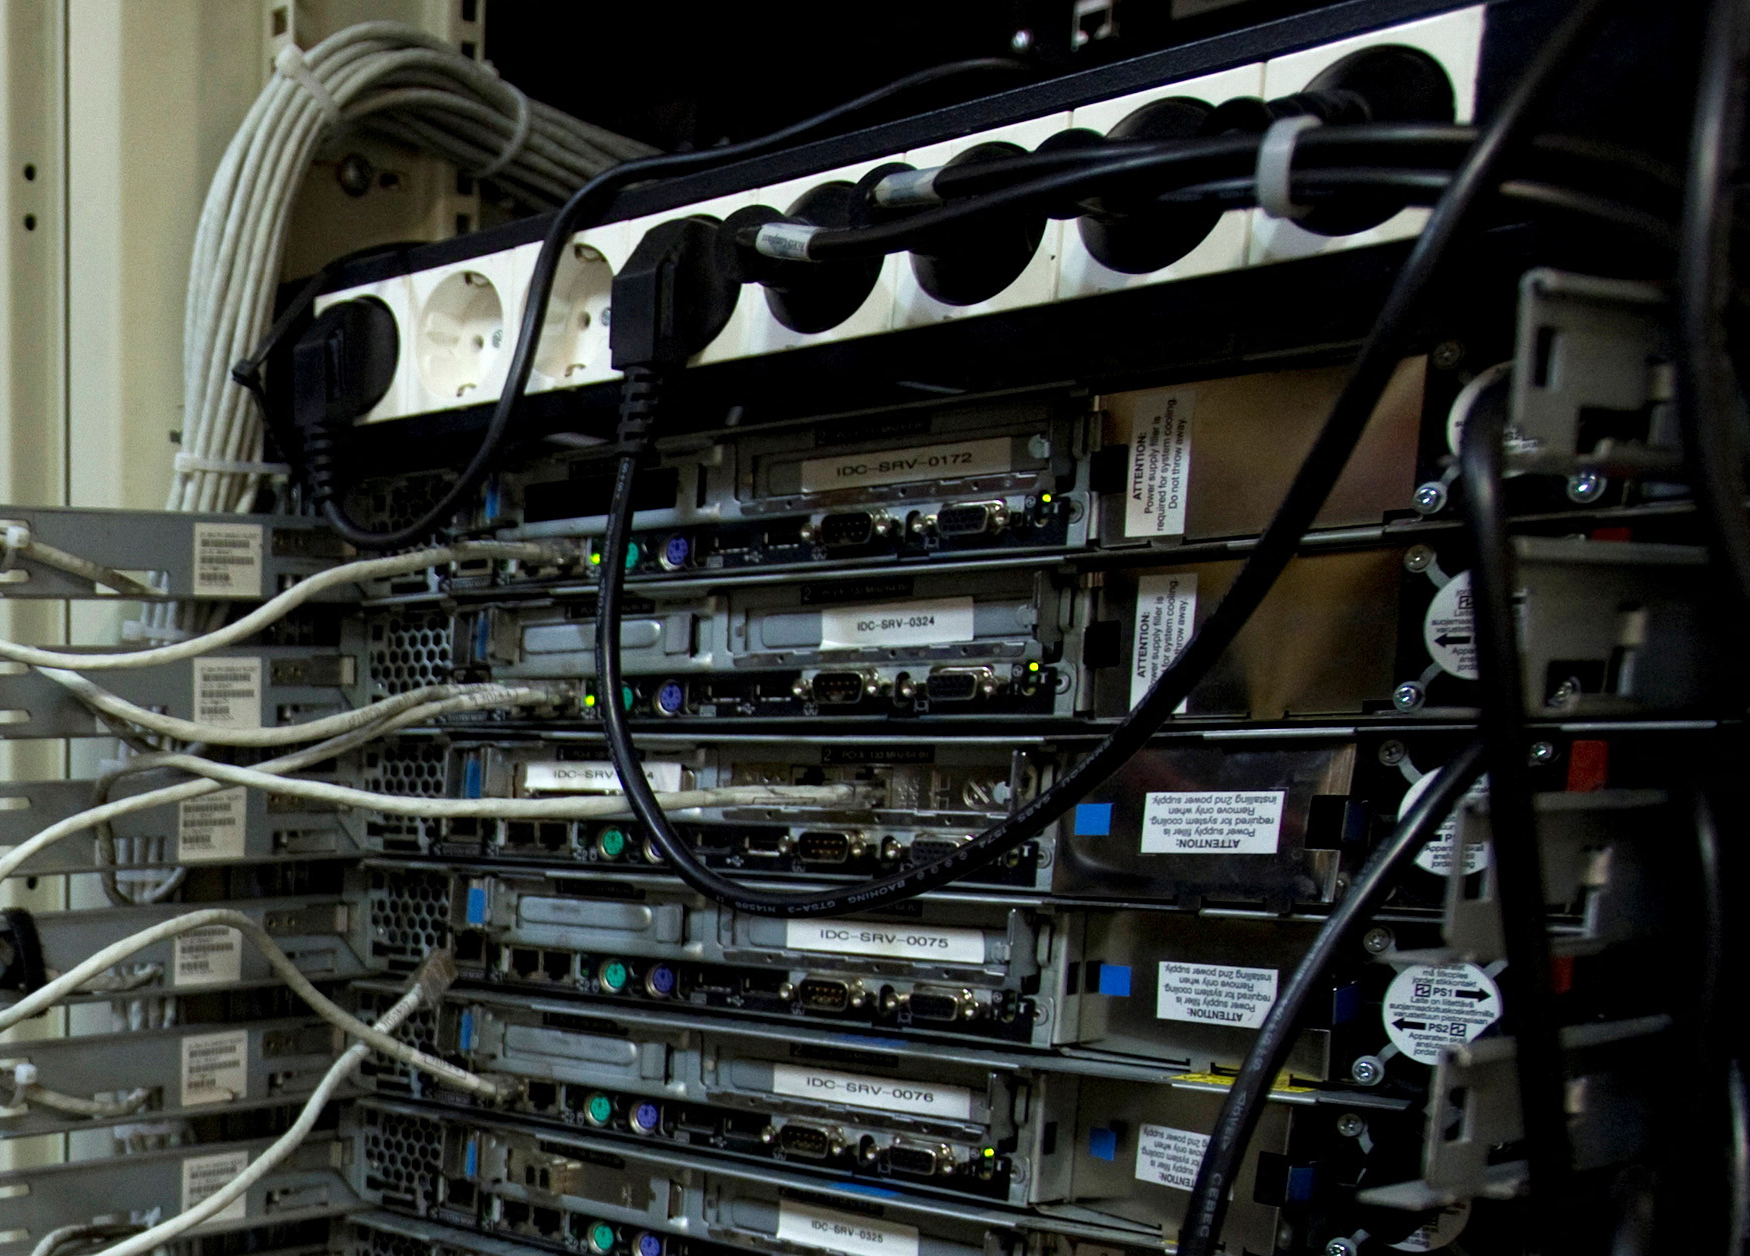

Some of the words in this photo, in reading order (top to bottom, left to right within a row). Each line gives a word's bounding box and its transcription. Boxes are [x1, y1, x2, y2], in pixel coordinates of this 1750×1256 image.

[1152, 415, 1161, 424] is
[1151, 426, 1160, 447] filler
[1160, 437, 1171, 473] system
[1171, 446, 1183, 475] throw
[836, 452, 972, 477] IDC-SRV-0172
[1133, 431, 1148, 500] ATTENTION:
[1147, 449, 1159, 482] supply
[1157, 475, 1166, 489] for
[1169, 476, 1180, 493] not
[1144, 484, 1155, 514] Power
[1168, 494, 1178, 510] Do
[1156, 490, 1167, 531] required
[1154, 595, 1164, 605] is
[1153, 606, 1162, 626] filler
[1177, 597, 1189, 626] away.
[855, 615, 935, 632] IDC-SRV-0324
[1163, 617, 1174, 653] system
[1137, 611, 1150, 678] ATTENTION:
[1151, 628, 1163, 660] supply
[1160, 654, 1170, 669] for
[1152, 795, 1182, 806] supply.
[1183, 795, 1213, 804] power
[1214, 796, 1233, 806] 2nd
[1235, 794, 1277, 805] installing
[1168, 807, 1192, 817] when
[1195, 805, 1215, 816] only
[1216, 806, 1256, 816] Remove
[1149, 815, 1184, 827] cooling.
[1185, 815, 1218, 826] system
[1219, 817, 1232, 827] for
[1234, 816, 1274, 827] required
[1163, 828, 1171, 837] is
[1173, 828, 1192, 837] filler
[1194, 826, 1224, 837] supply
[1226, 828, 1256, 838] Power
[1176, 839, 1241, 848] ATTENTION:
[847, 880, 907, 905] BAOHING
[787, 899, 837, 914] GTSA-3
[819, 928, 949, 949] IDC-SRV-0075
[1192, 967, 1217, 977] power
[1218, 970, 1235, 980] 2nd
[1235, 969, 1272, 983] installing
[1179, 977, 1200, 987] when
[1202, 978, 1219, 989] only
[1220, 980, 1254, 992] Remove
[1194, 988, 1222, 1000] system
[1224, 991, 1235, 1001] for
[1236, 992, 1271, 1003] required
[1433, 987, 1453, 998] PS1
[1176, 996, 1183, 1006] is
[1184, 997, 1201, 1007] filler
[1202, 997, 1228, 1009] supply
[1231, 1001, 1256, 1013] Power
[1186, 1008, 1244, 1022] ATTENTION:
[1428, 1022, 1450, 1034] PS2
[805, 1076, 934, 1103] IDC-SRV-0076
[1158, 1172, 1195, 1189] TENTION:
